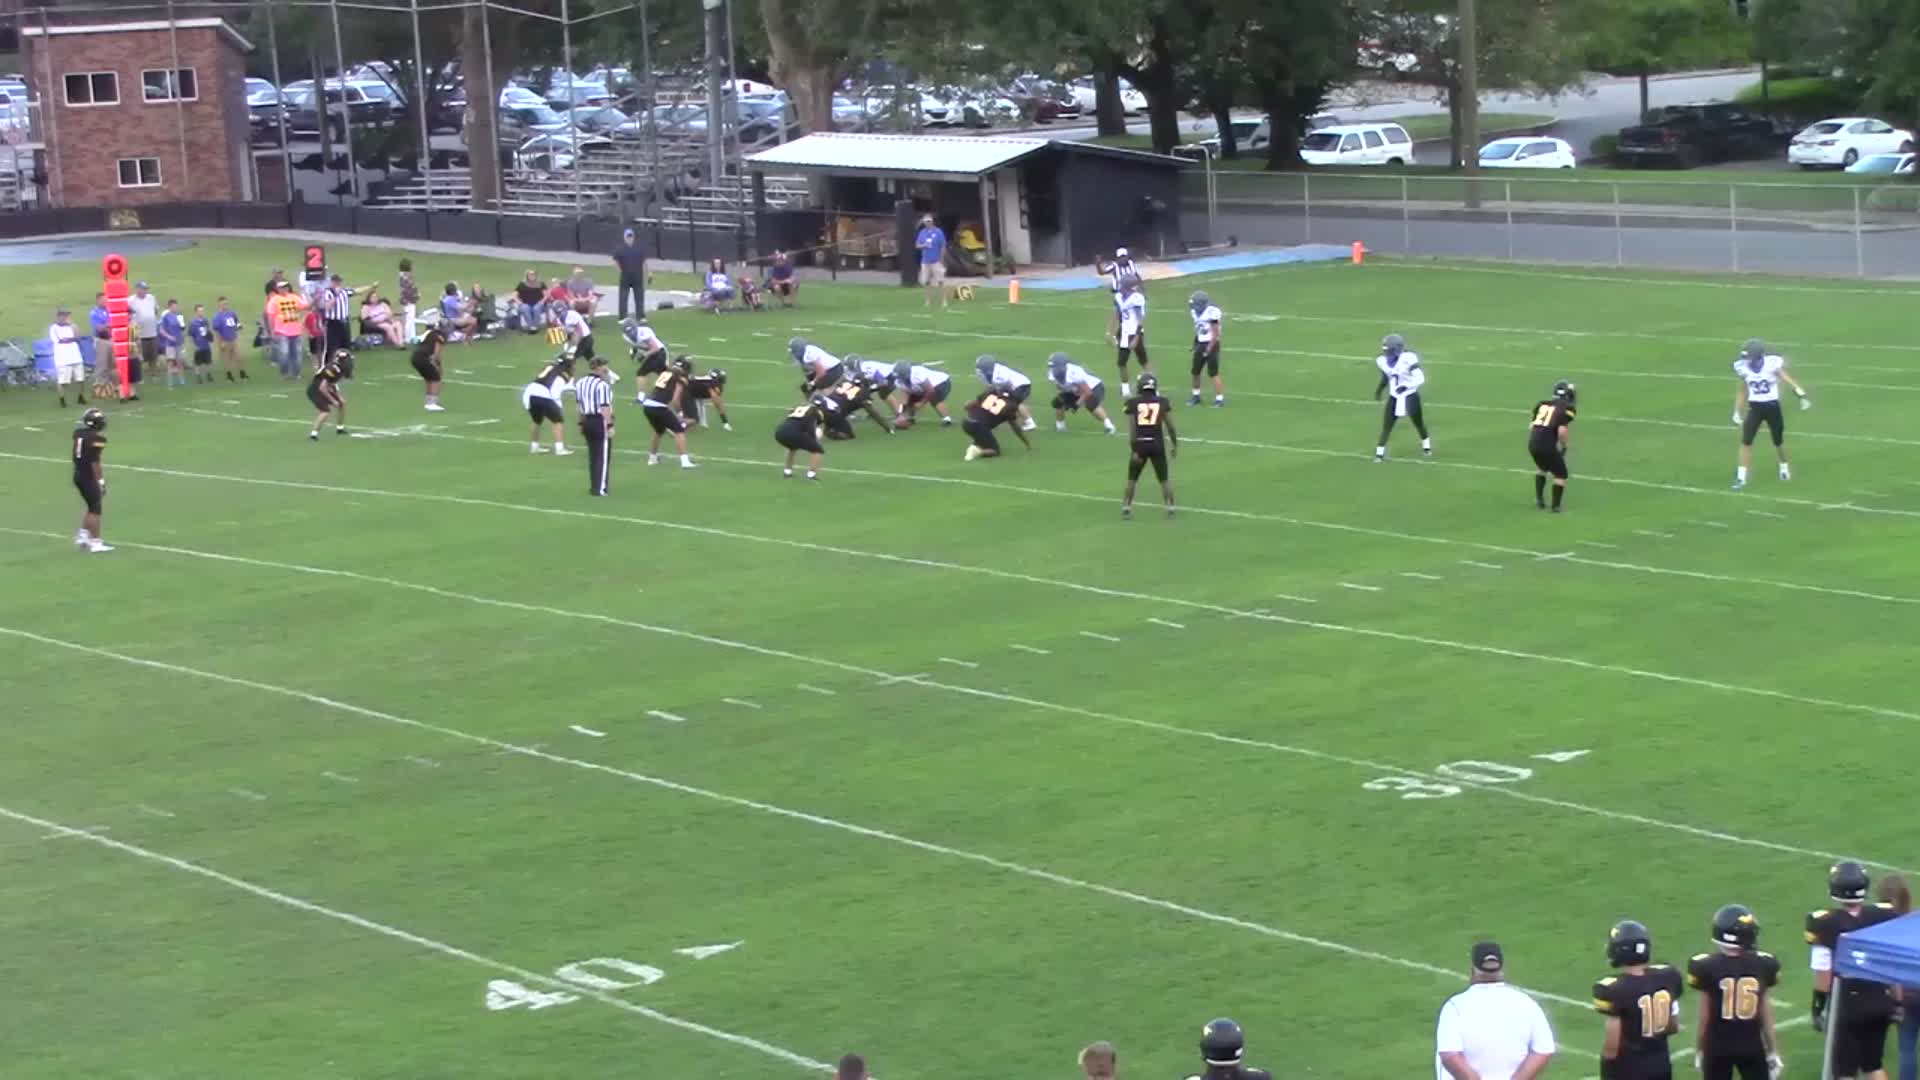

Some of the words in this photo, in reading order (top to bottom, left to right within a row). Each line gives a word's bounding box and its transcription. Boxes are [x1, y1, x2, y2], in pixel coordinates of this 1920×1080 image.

[307, 247, 322, 268] 2
[1137, 403, 1160, 425] 27
[1362, 760, 1533, 799] 30
[485, 957, 665, 1010] 40
[1719, 977, 1759, 1020] 16
[1638, 989, 1671, 1037] 10
